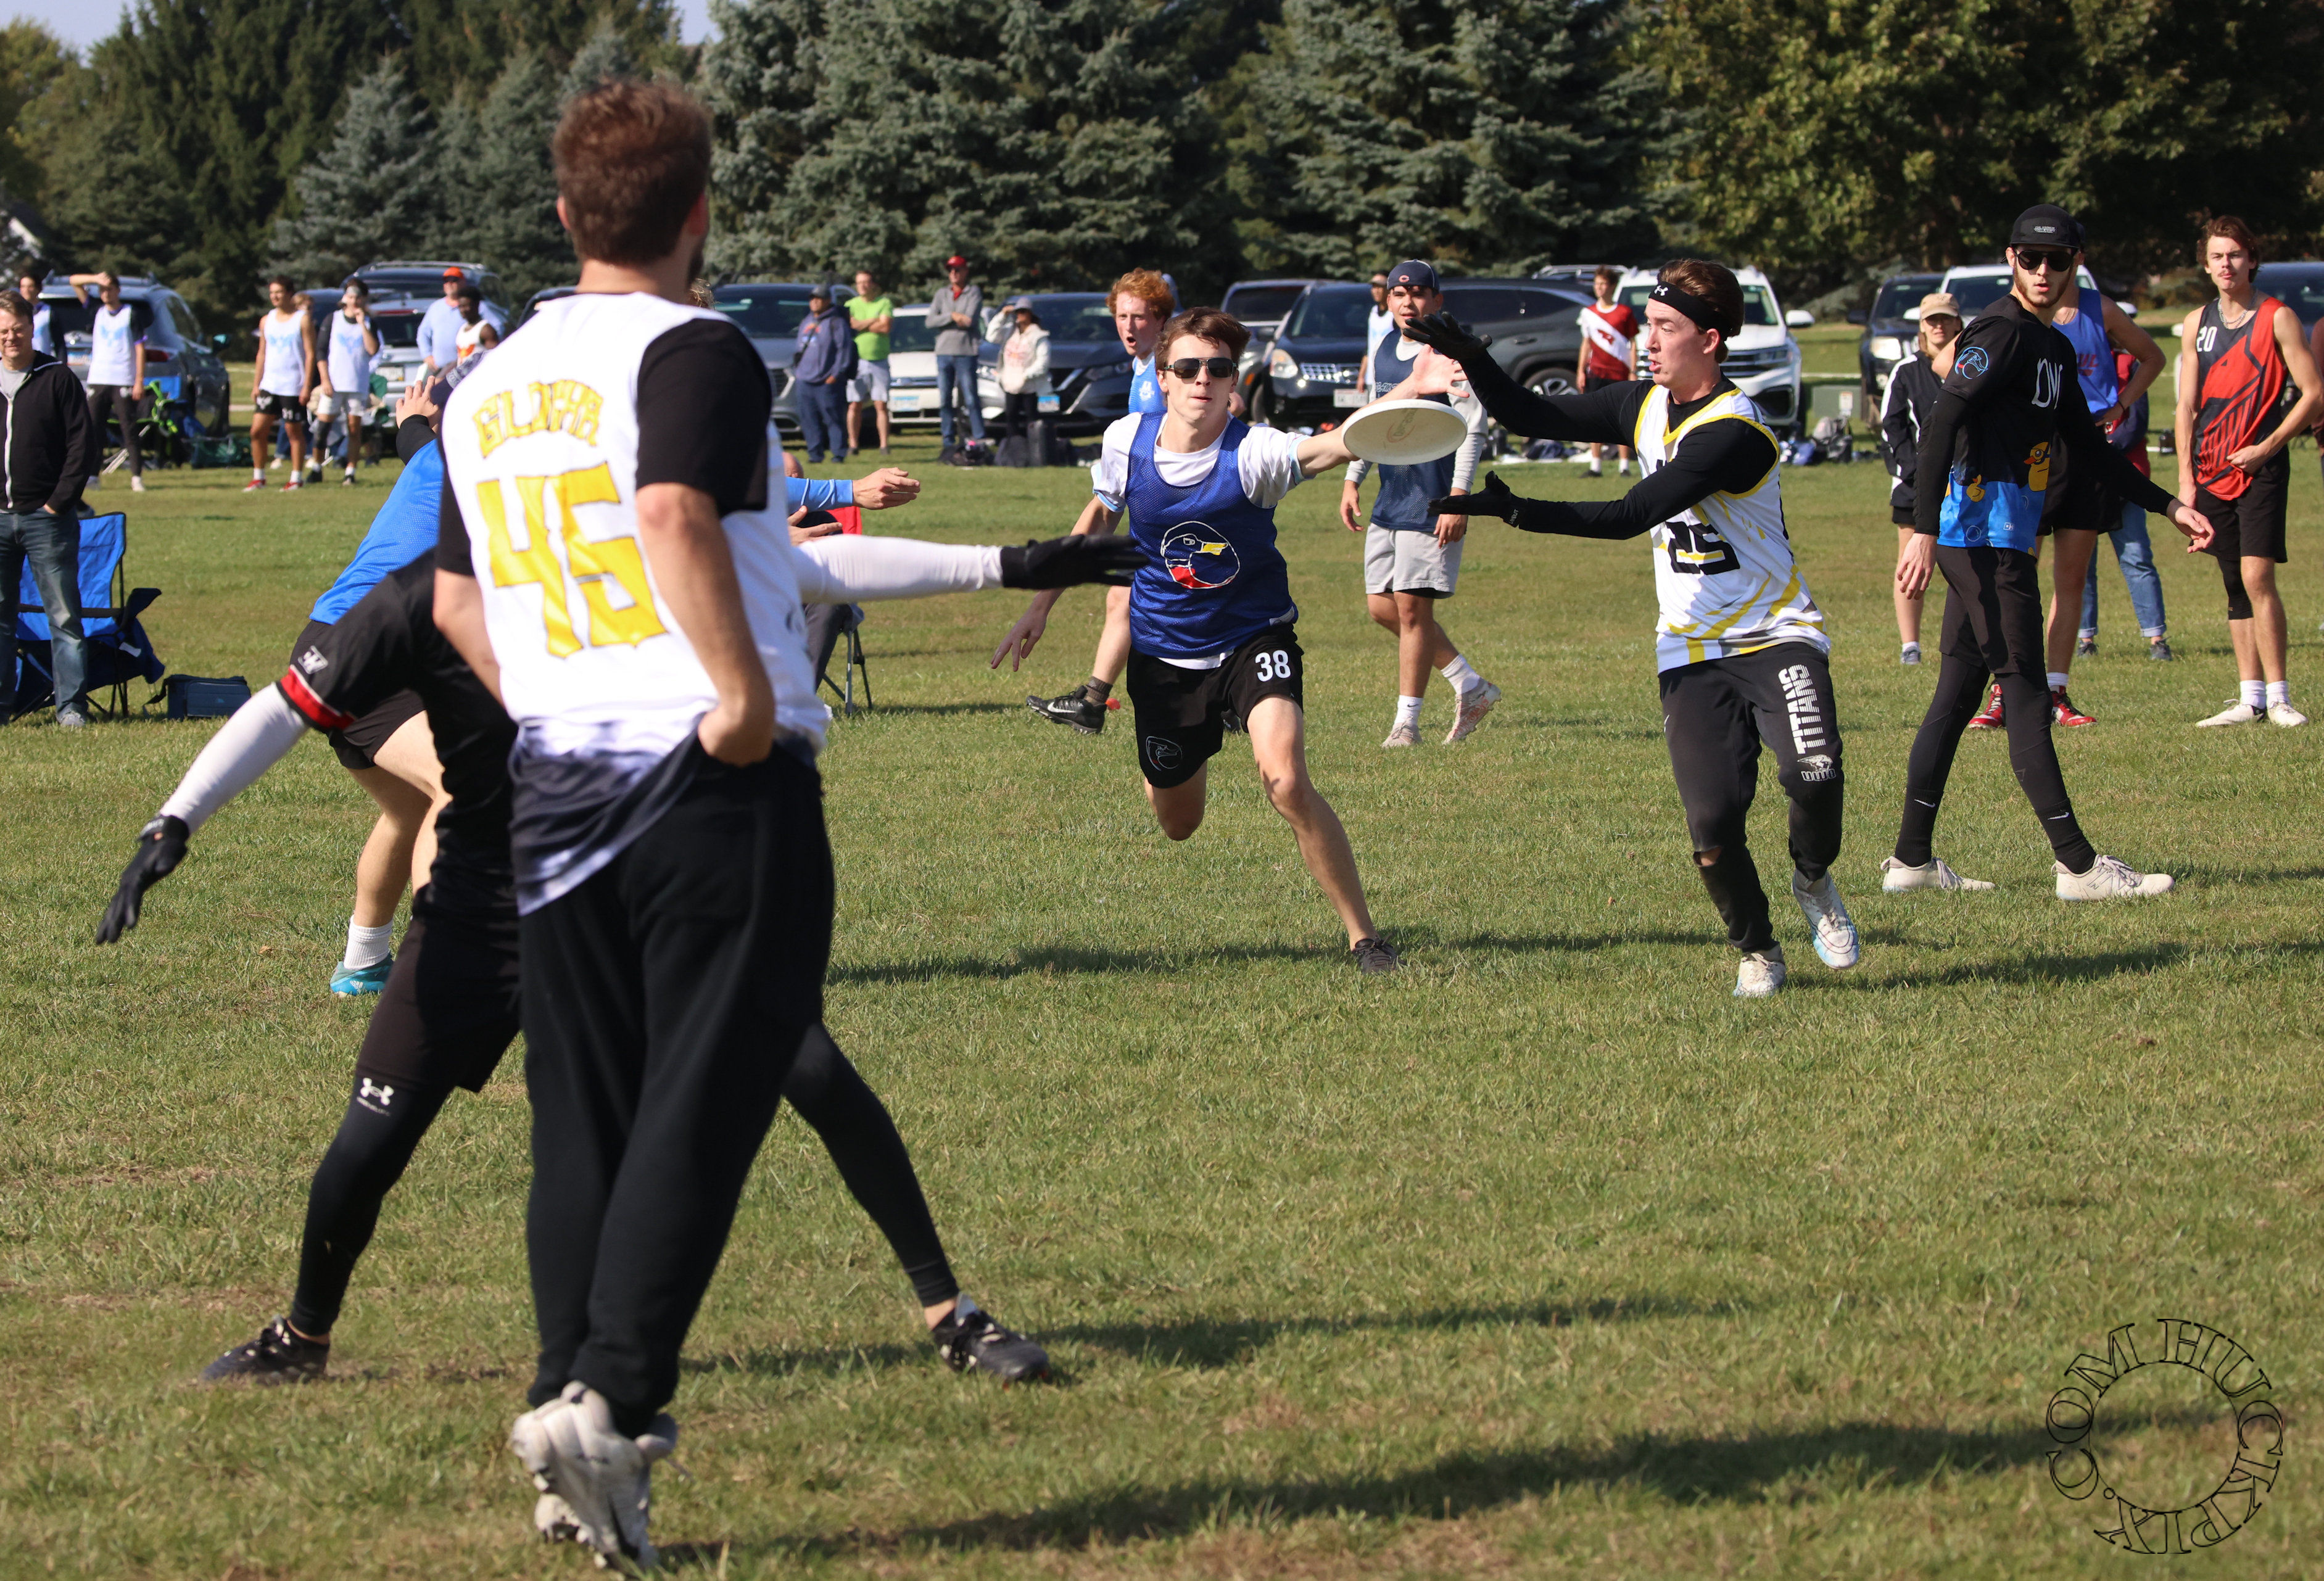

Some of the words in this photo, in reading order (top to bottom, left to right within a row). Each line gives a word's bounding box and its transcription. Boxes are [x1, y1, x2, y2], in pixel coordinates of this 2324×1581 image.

[2196, 326, 2217, 352] 20
[476, 460, 670, 659] 46
[1667, 521, 1740, 576] 25
[1255, 650, 1291, 682] 38
[1777, 664, 1826, 754] TITANS
[1801, 768, 1837, 782] UWO
